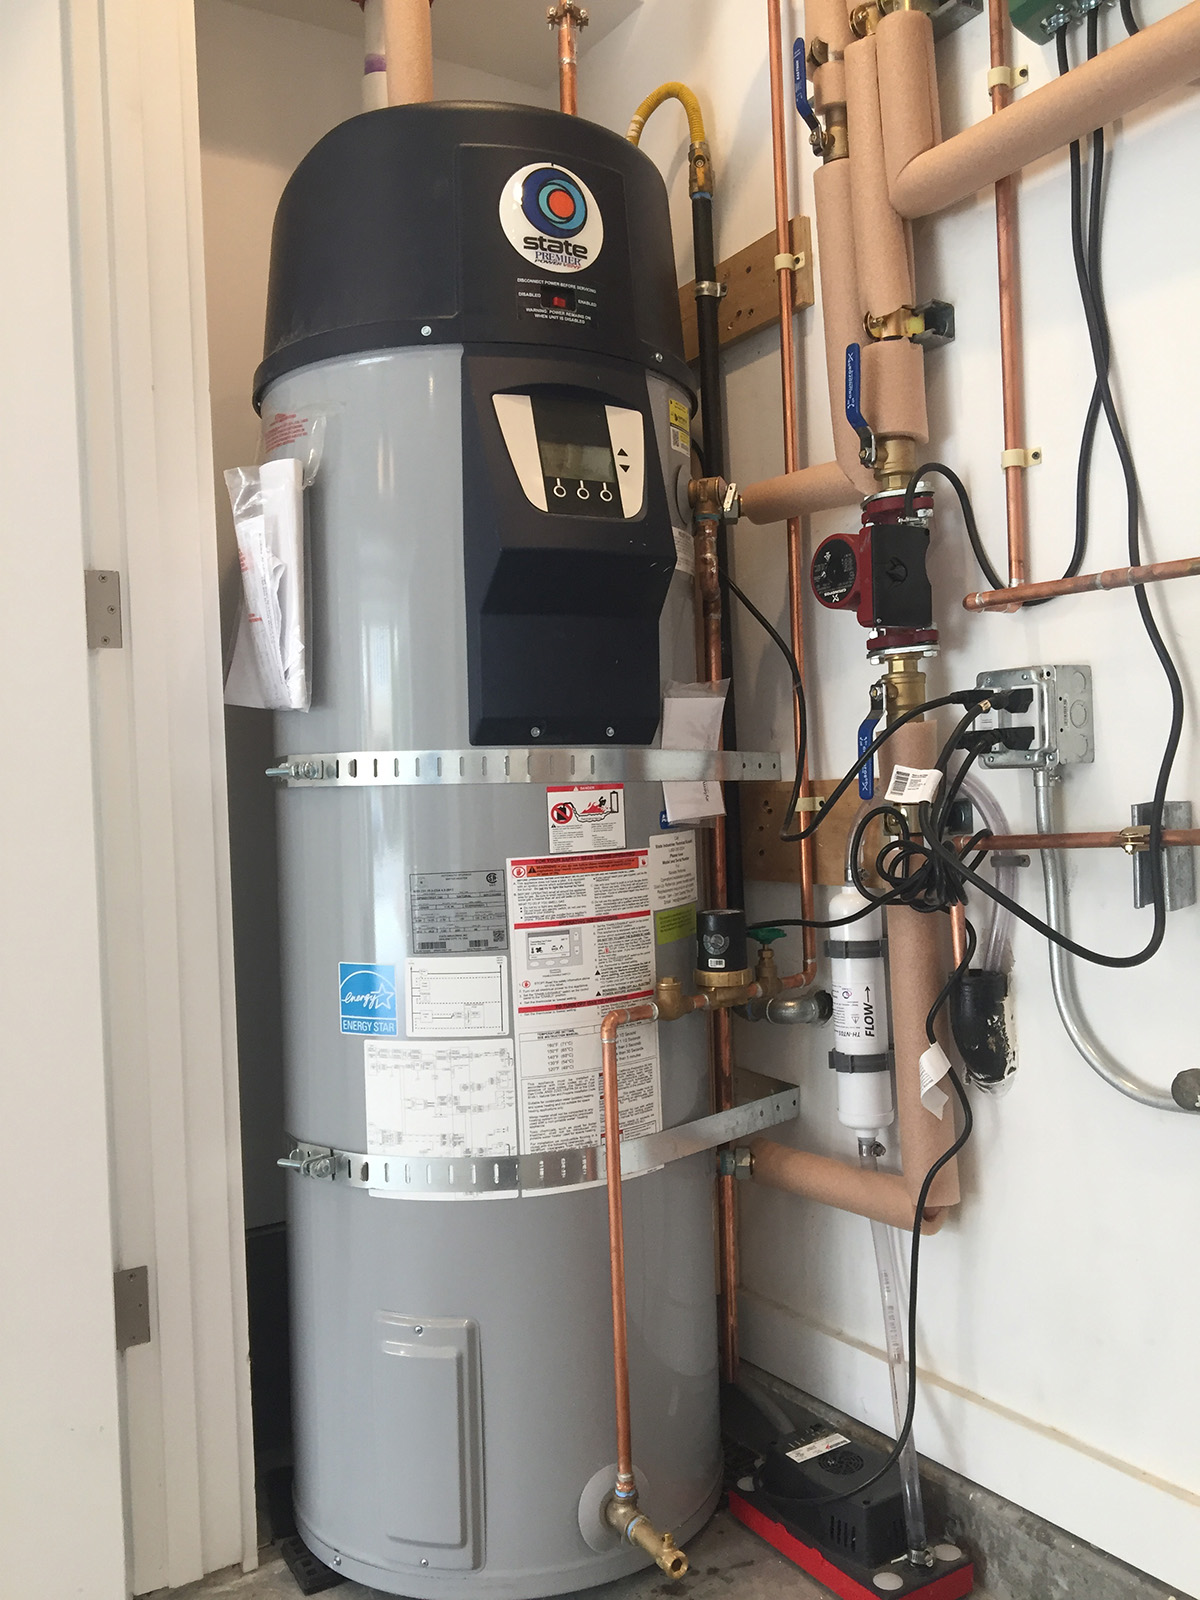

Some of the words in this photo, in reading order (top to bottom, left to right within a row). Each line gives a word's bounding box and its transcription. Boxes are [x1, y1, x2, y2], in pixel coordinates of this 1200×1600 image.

[523, 236, 588, 260] state
[535, 252, 582, 265] PREMIER
[577, 285, 597, 294] SERVICING
[578, 300, 598, 308] ENABLED
[342, 991, 378, 1010] energy
[342, 1020, 372, 1032] ENERGY
[373, 1021, 394, 1032] STAR
[863, 1002, 875, 1037] FLOW
